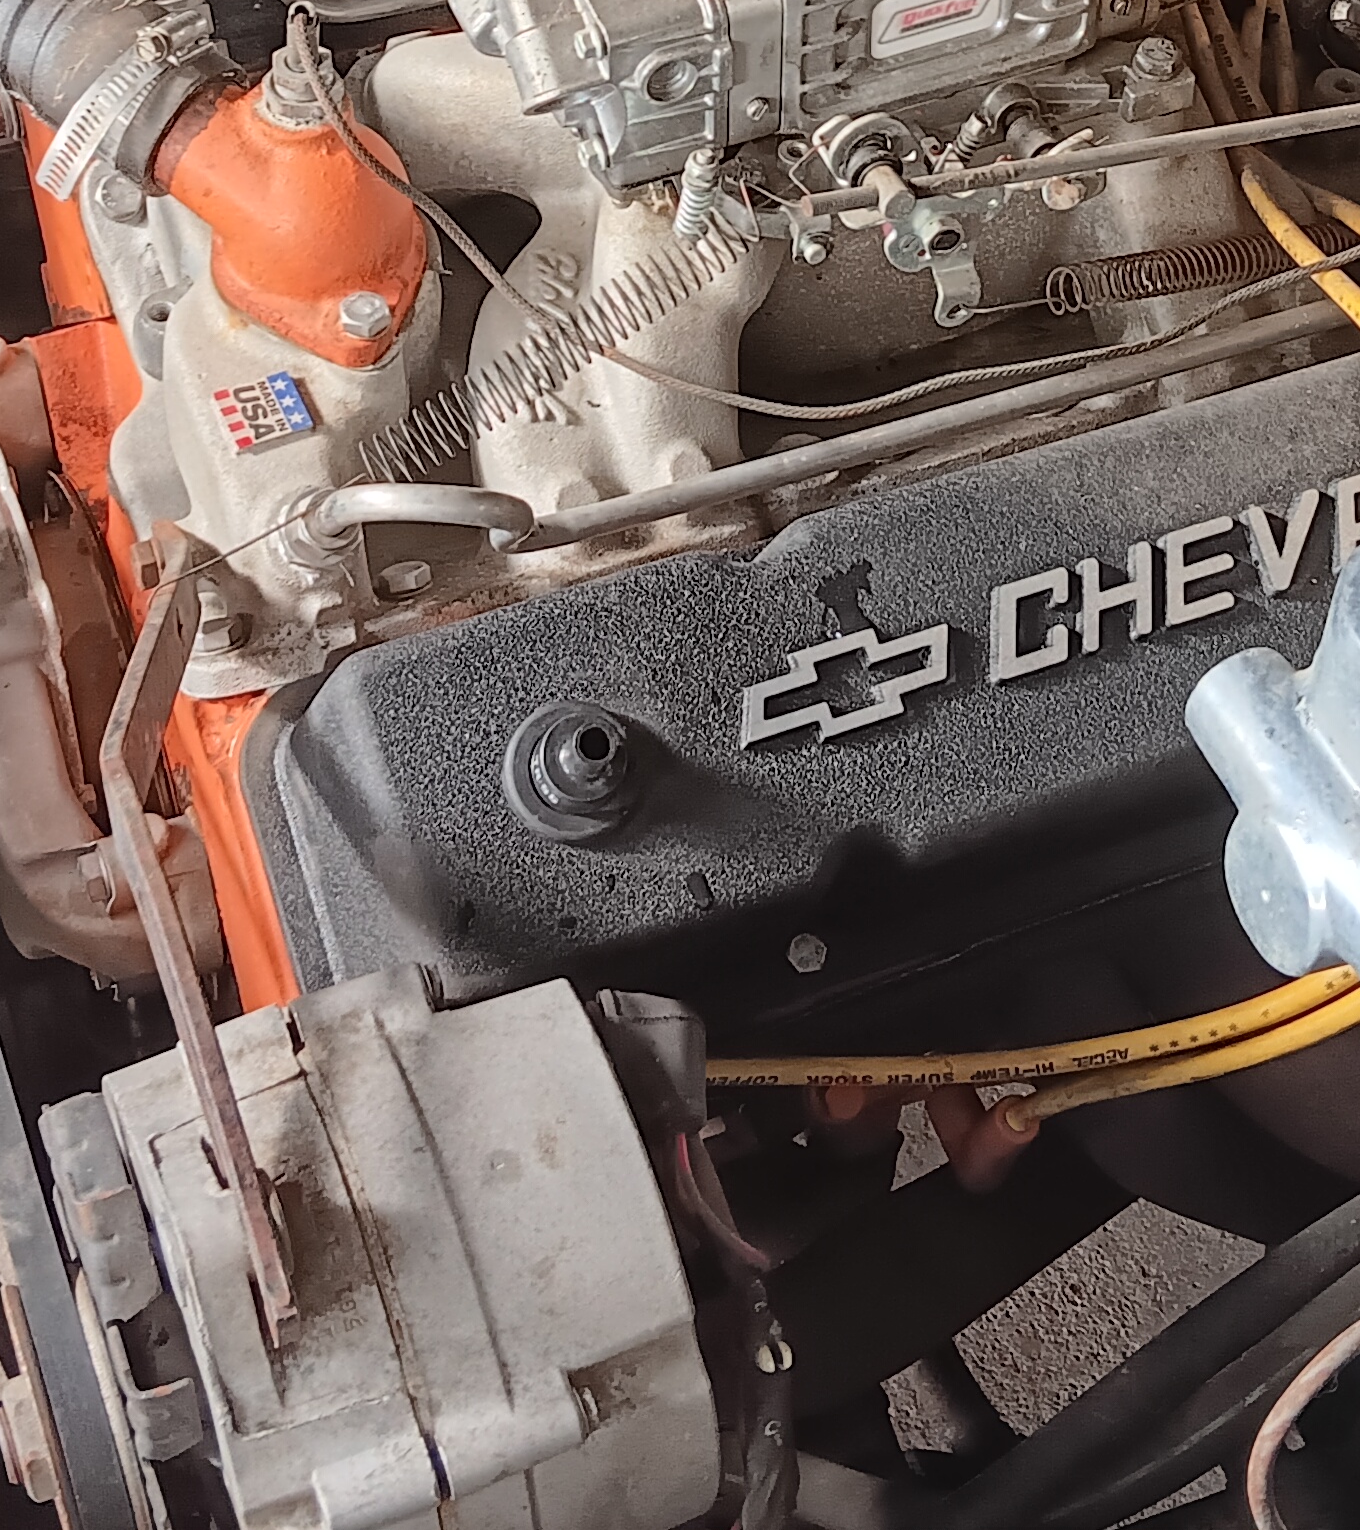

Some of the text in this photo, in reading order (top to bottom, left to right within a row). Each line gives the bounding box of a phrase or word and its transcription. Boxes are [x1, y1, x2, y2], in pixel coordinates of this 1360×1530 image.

[232, 384, 276, 440] USA
[256, 380, 289, 433] MADE IN
[887, 1070, 955, 1087] SUPER
[974, 1060, 1055, 1082] HI-TEMP
